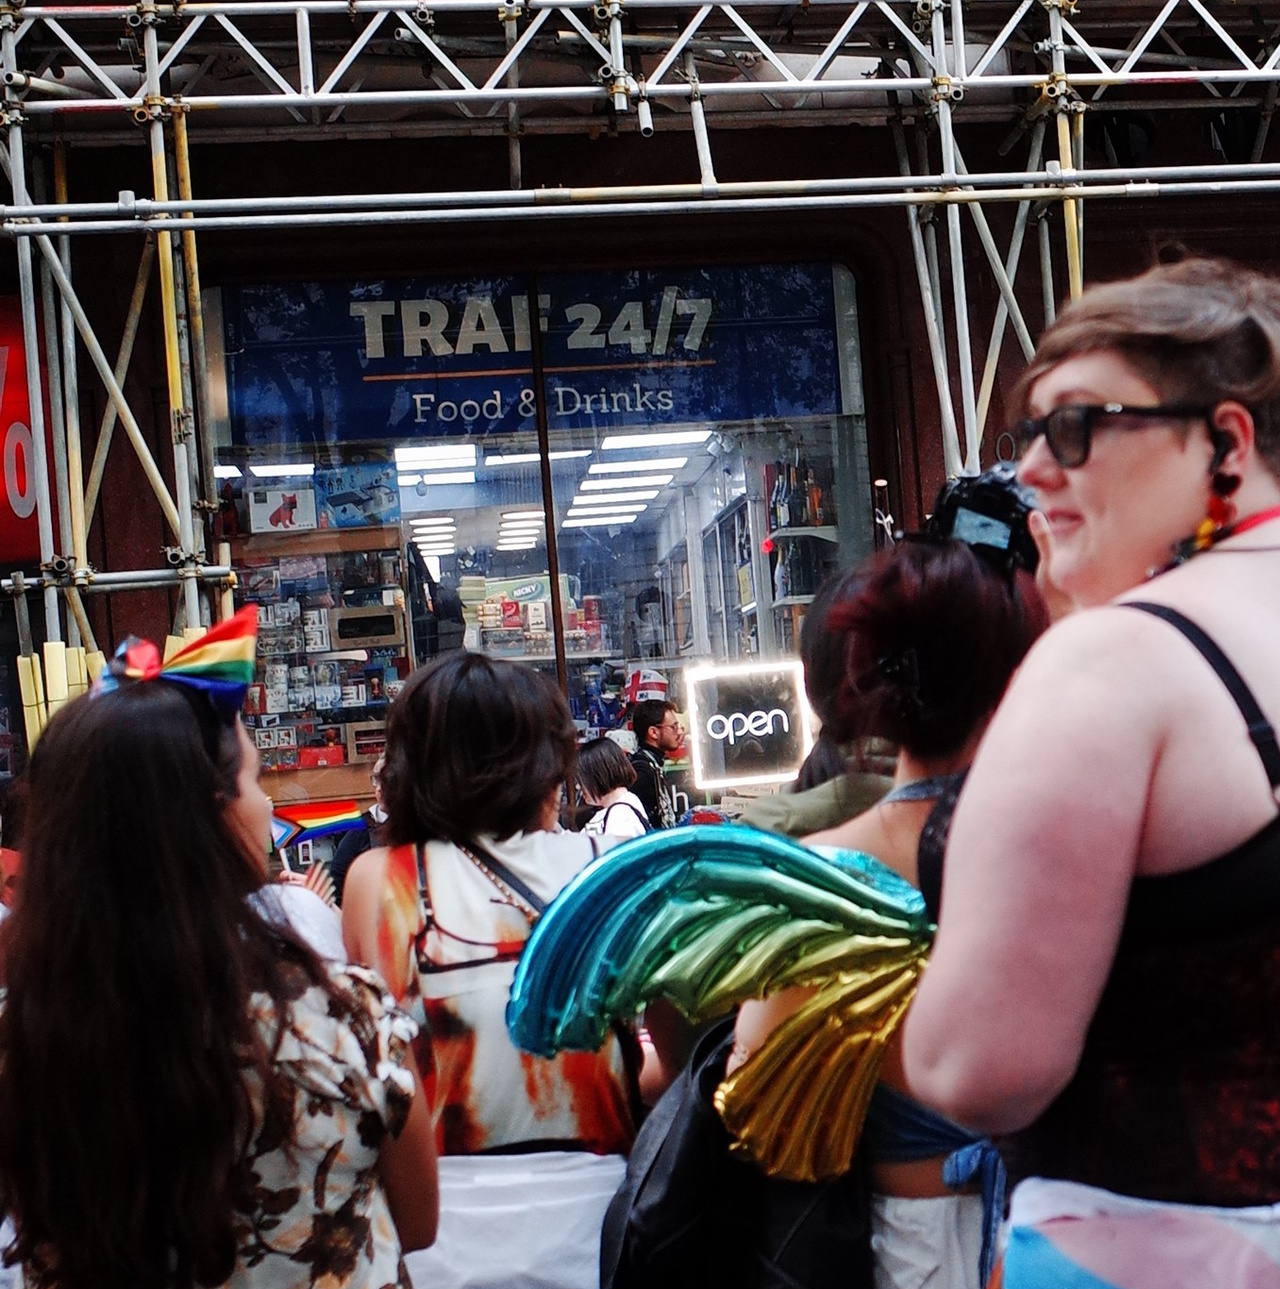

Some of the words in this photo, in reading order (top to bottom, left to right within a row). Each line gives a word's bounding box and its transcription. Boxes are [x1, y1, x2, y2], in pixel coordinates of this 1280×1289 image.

[564, 286, 713, 355] 24/7
[412, 390, 505, 423] Food
[518, 388, 537, 418] &
[554, 383, 674, 416] Drinks
[513, 583, 537, 598] NICKY
[706, 708, 789, 746] open
